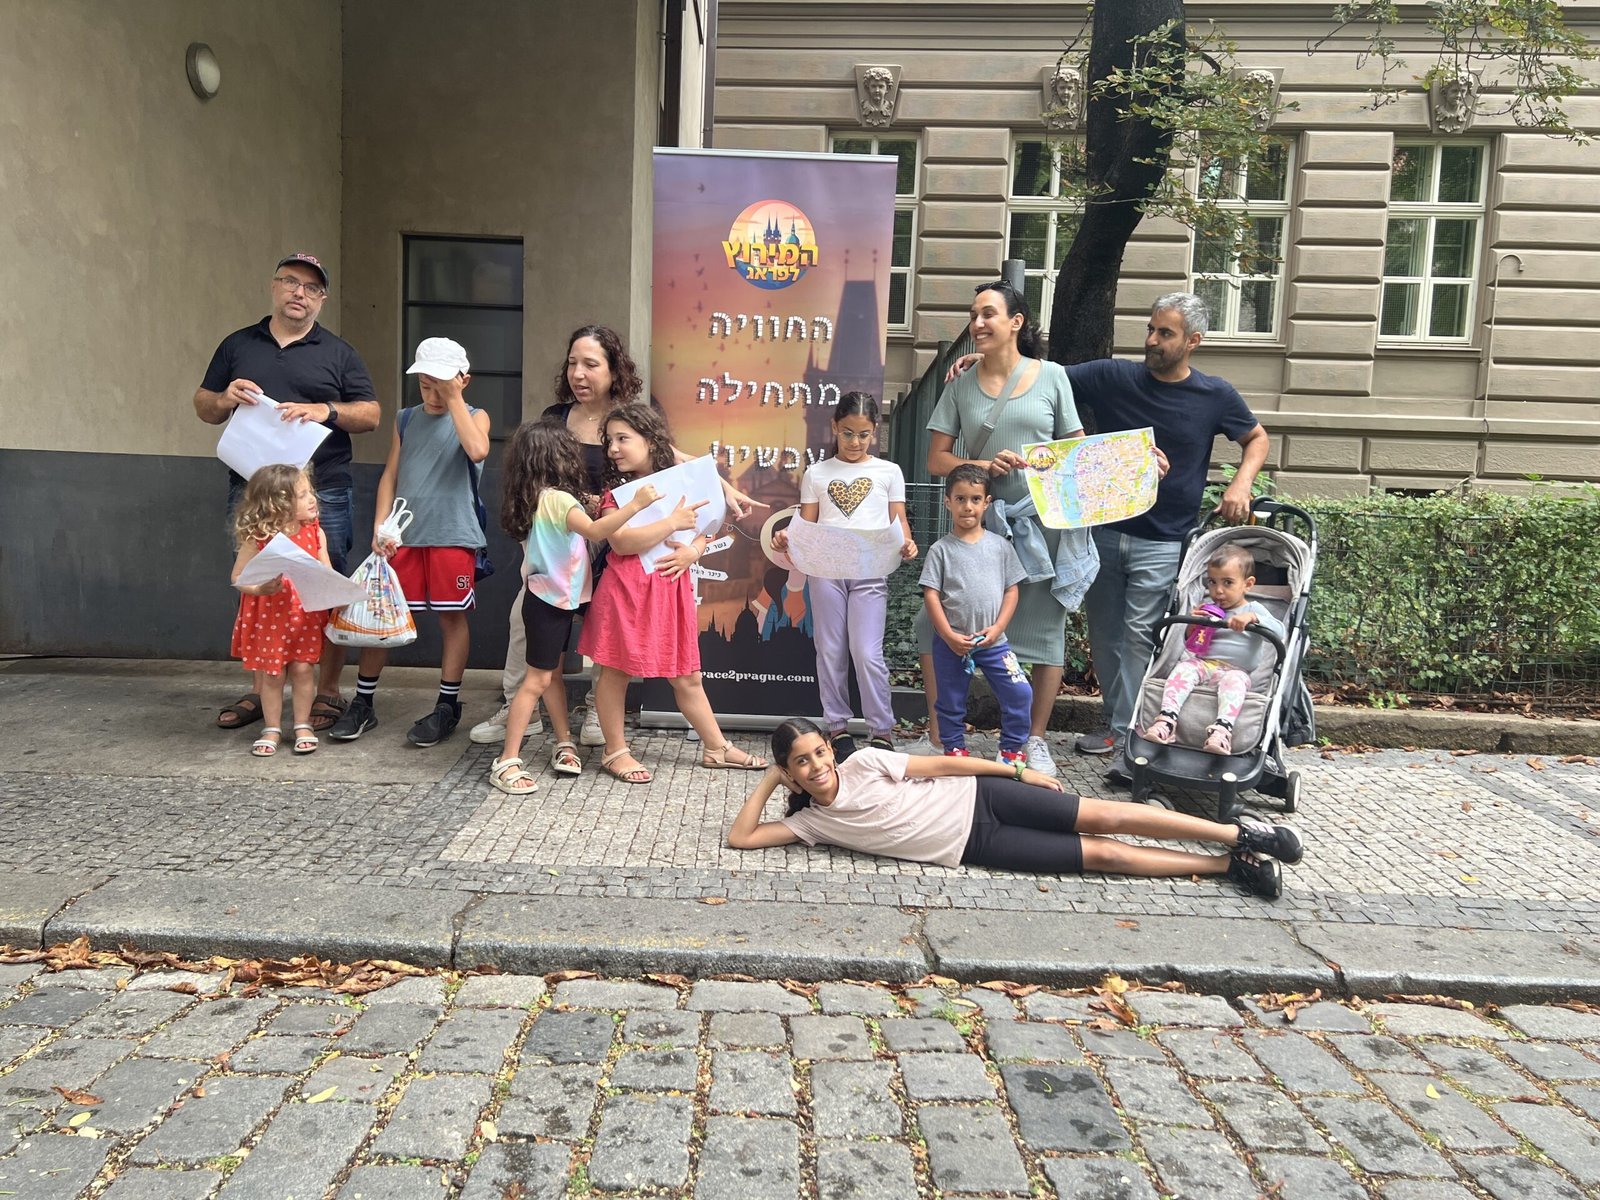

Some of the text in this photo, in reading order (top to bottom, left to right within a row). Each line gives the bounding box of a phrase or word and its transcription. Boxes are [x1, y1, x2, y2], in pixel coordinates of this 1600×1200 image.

[722, 241, 818, 268] המירוץ
[746, 267, 800, 281] לפראג
[711, 312, 832, 339] החוויה
[699, 372, 840, 405] מתחילה
